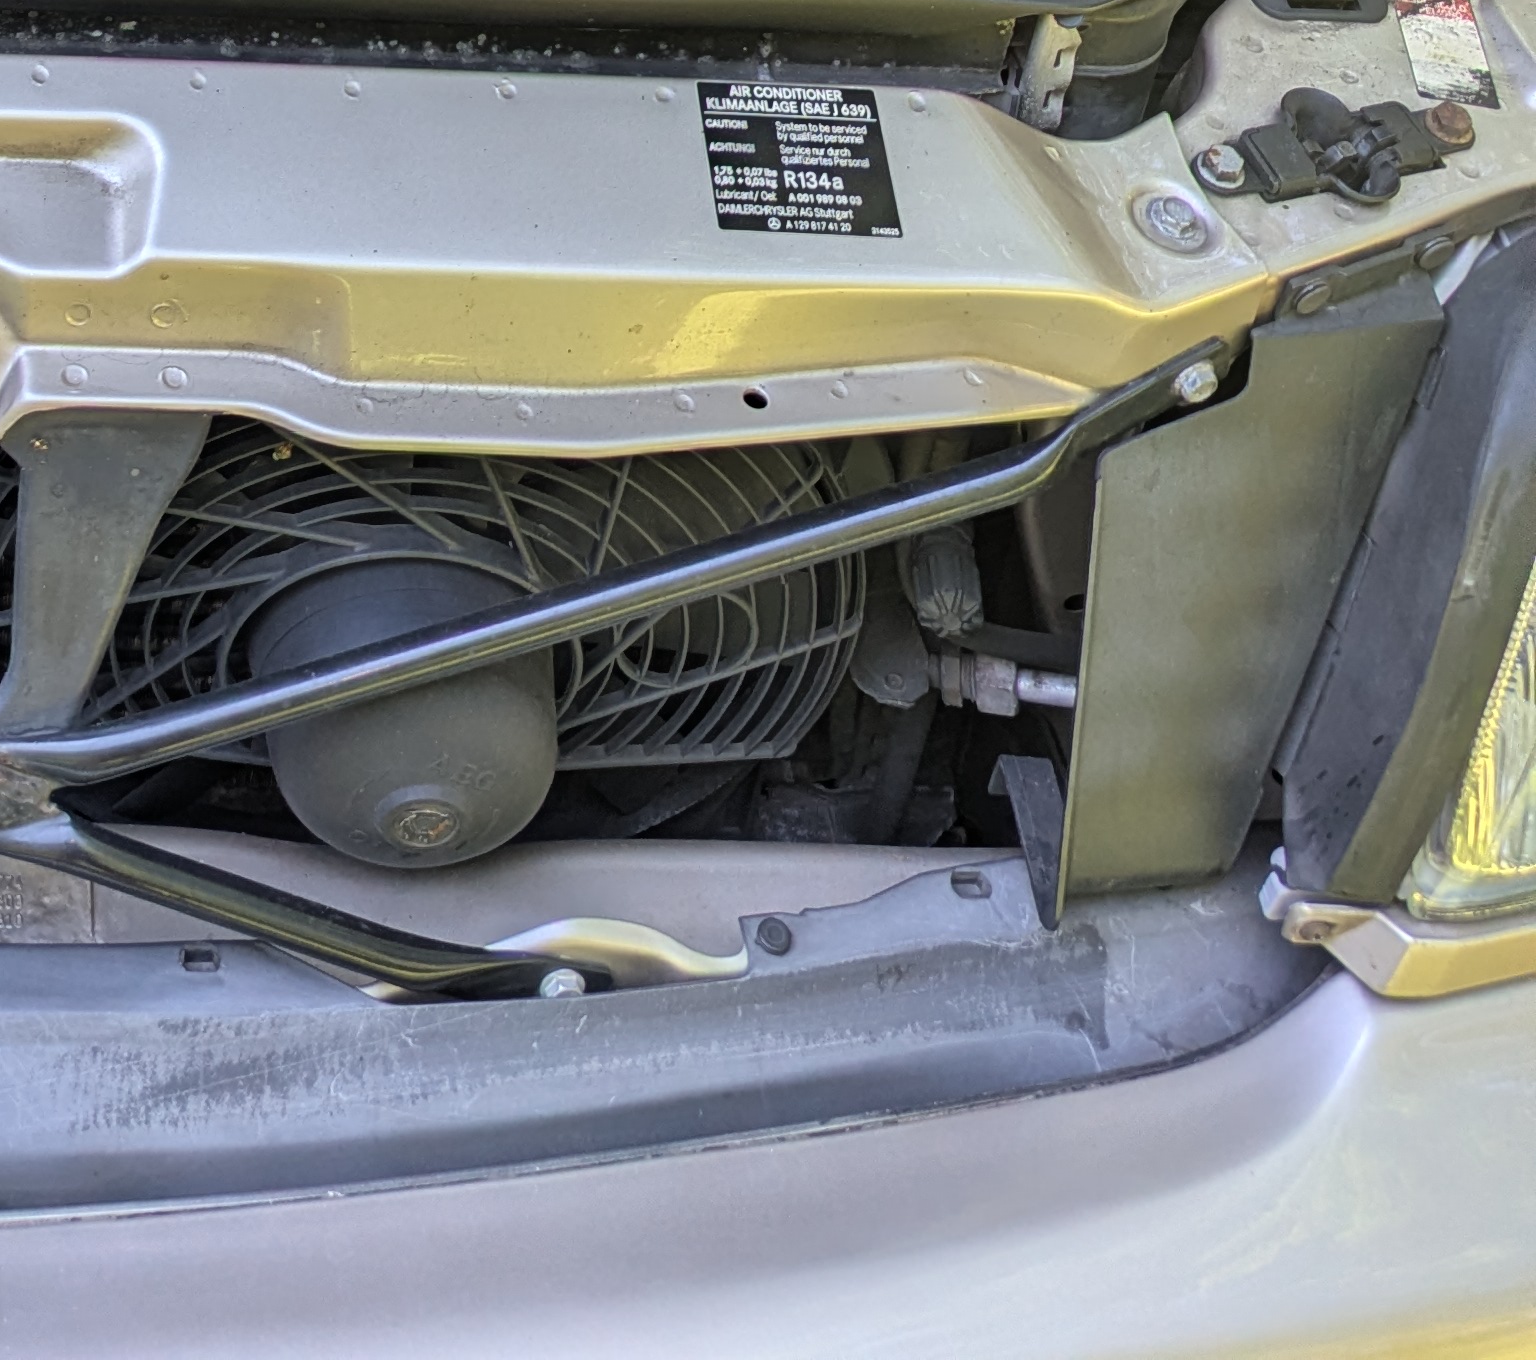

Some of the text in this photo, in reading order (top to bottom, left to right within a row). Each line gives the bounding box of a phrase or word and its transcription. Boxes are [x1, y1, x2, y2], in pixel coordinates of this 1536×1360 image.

[729, 84, 843, 103] AIR CONDITIONER
[705, 97, 871, 119] KLIMAANLAGE (SAE J 639)
[775, 121, 868, 135] System to be serviced
[776, 132, 865, 145] by qualified personnel
[779, 144, 851, 157] Service nur durch
[834, 157, 870, 168] Personal
[766, 178, 779, 190] kg
[783, 170, 845, 191] R134a
[788, 193, 797, 203] A
[800, 207, 814, 218] AG
[814, 208, 854, 221] Stuttgart
[785, 220, 794, 230] A
[794, 221, 810, 231] 129
[828, 222, 839, 232] 41
[840, 223, 852, 233] 20
[428, 753, 497, 791] AEG
